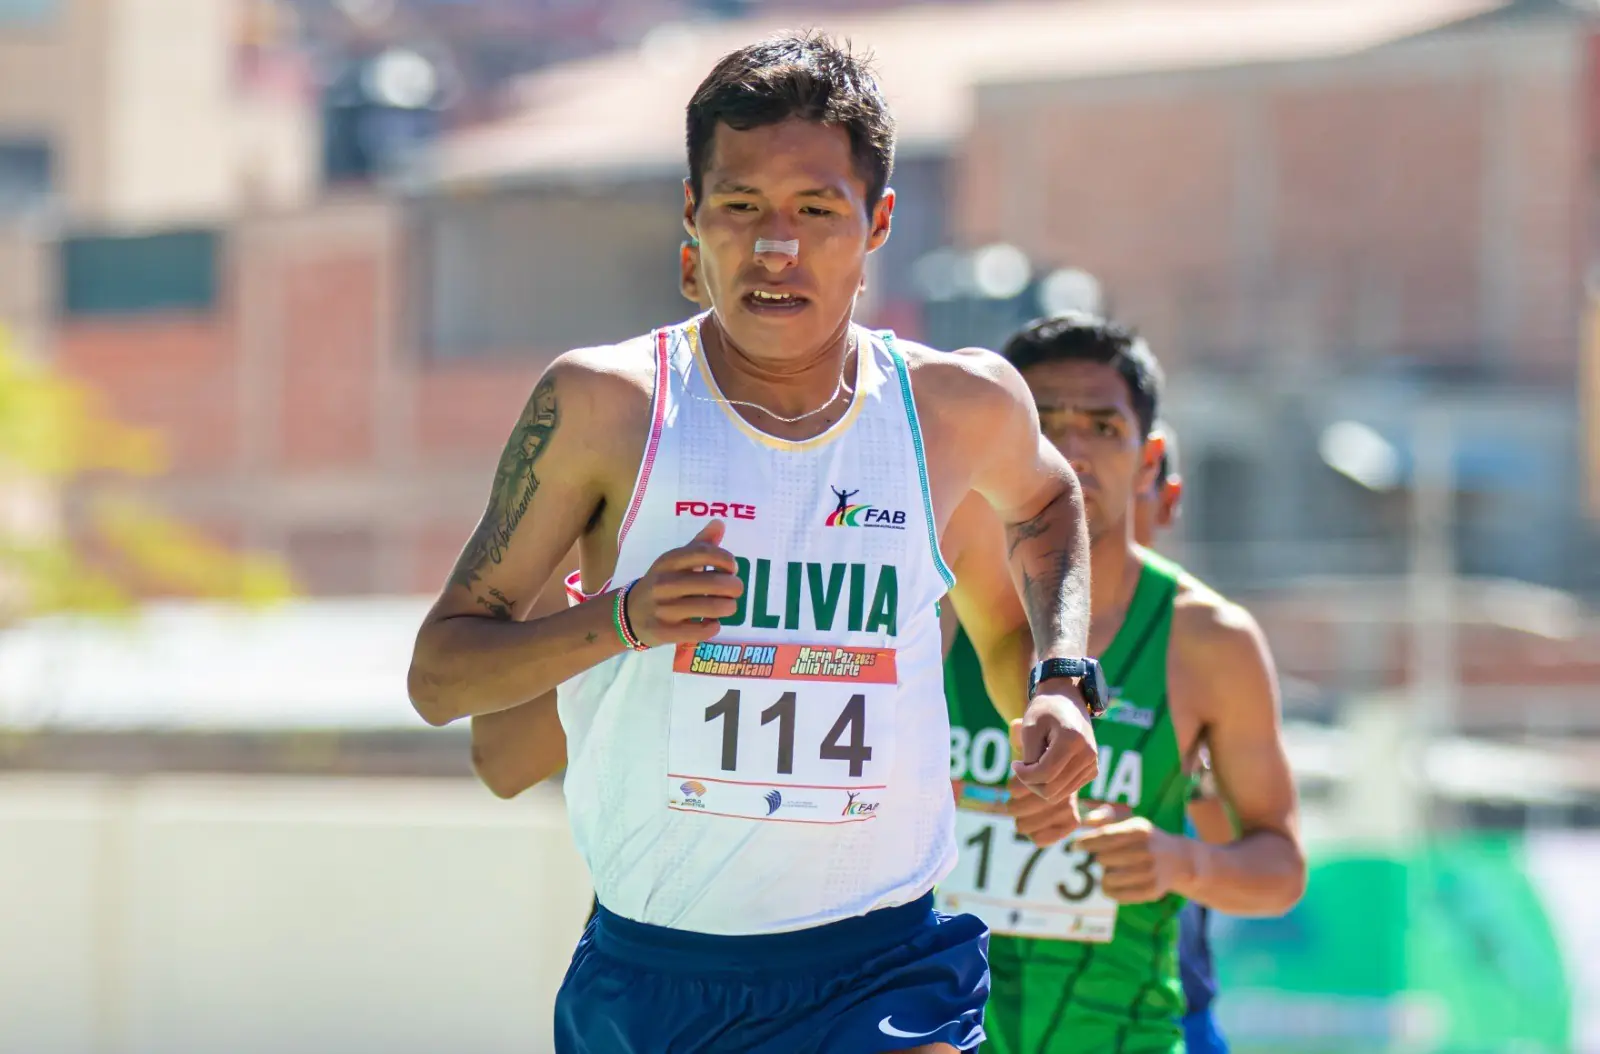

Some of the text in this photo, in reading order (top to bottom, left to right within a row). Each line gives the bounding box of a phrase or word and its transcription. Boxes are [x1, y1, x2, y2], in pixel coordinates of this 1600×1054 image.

[675, 501, 756, 520] FORTE
[864, 508, 906, 524] FAB
[692, 556, 898, 636] OLIVIA
[695, 642, 777, 665] GRAND PRIX
[800, 647, 875, 665] Maria Paz 2025
[691, 657, 773, 677] Sudamericano
[790, 659, 860, 677] Julia Iriarte
[704, 688, 872, 778] 114
[949, 725, 1143, 808] BOIA
[966, 825, 1096, 901] 173
